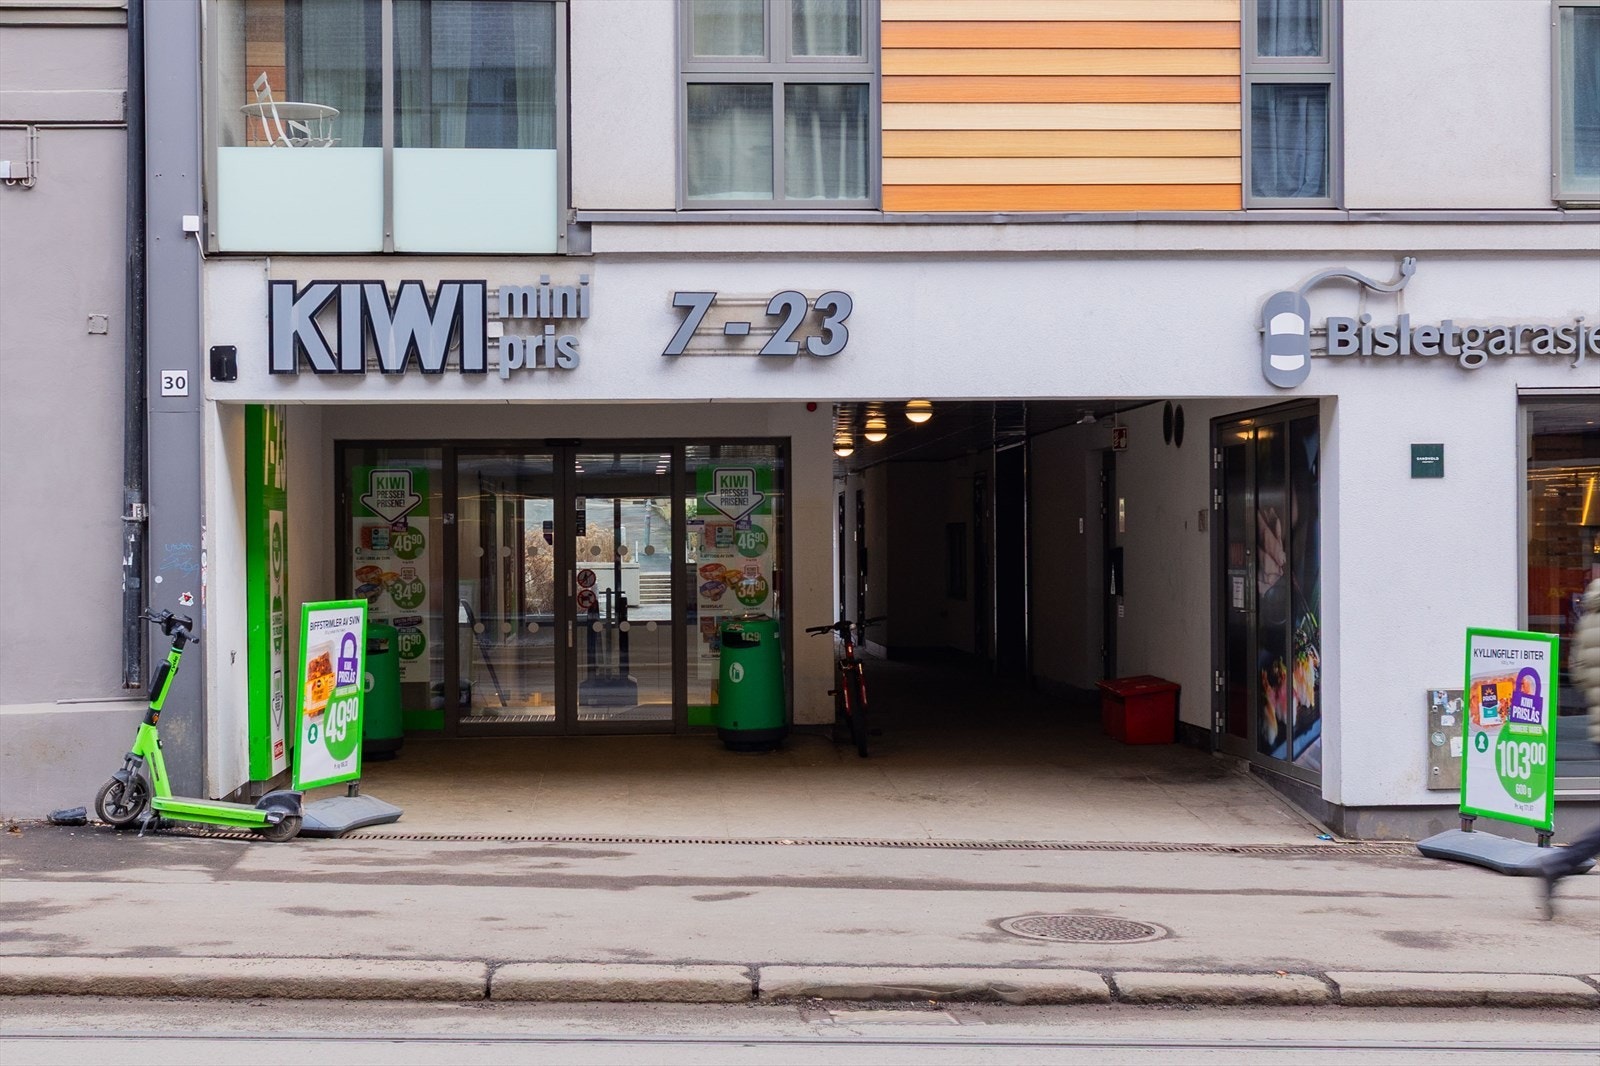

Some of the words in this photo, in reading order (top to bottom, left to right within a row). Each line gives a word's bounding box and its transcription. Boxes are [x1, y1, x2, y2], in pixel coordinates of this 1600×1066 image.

[268, 279, 488, 374] KIWI
[498, 275, 590, 318] mini
[662, 292, 717, 356] 7
[758, 291, 853, 357] 23
[498, 326, 580, 378] pris
[163, 376, 186, 390] 30
[376, 476, 405, 489] KIWI
[720, 475, 748, 488] KIWI
[376, 490, 405, 498] PRESSER
[376, 500, 406, 508] PRISENE!
[720, 498, 749, 506] PRISENE!
[310, 618, 342, 631] BIFFSTRIMLER
[349, 616, 360, 625] SVIN
[1473, 648, 1519, 659] KYLLINGFILET
[1524, 650, 1544, 660] BITER
[1520, 696, 1533, 707] KIWI
[1512, 706, 1539, 723] PRISLÅS
